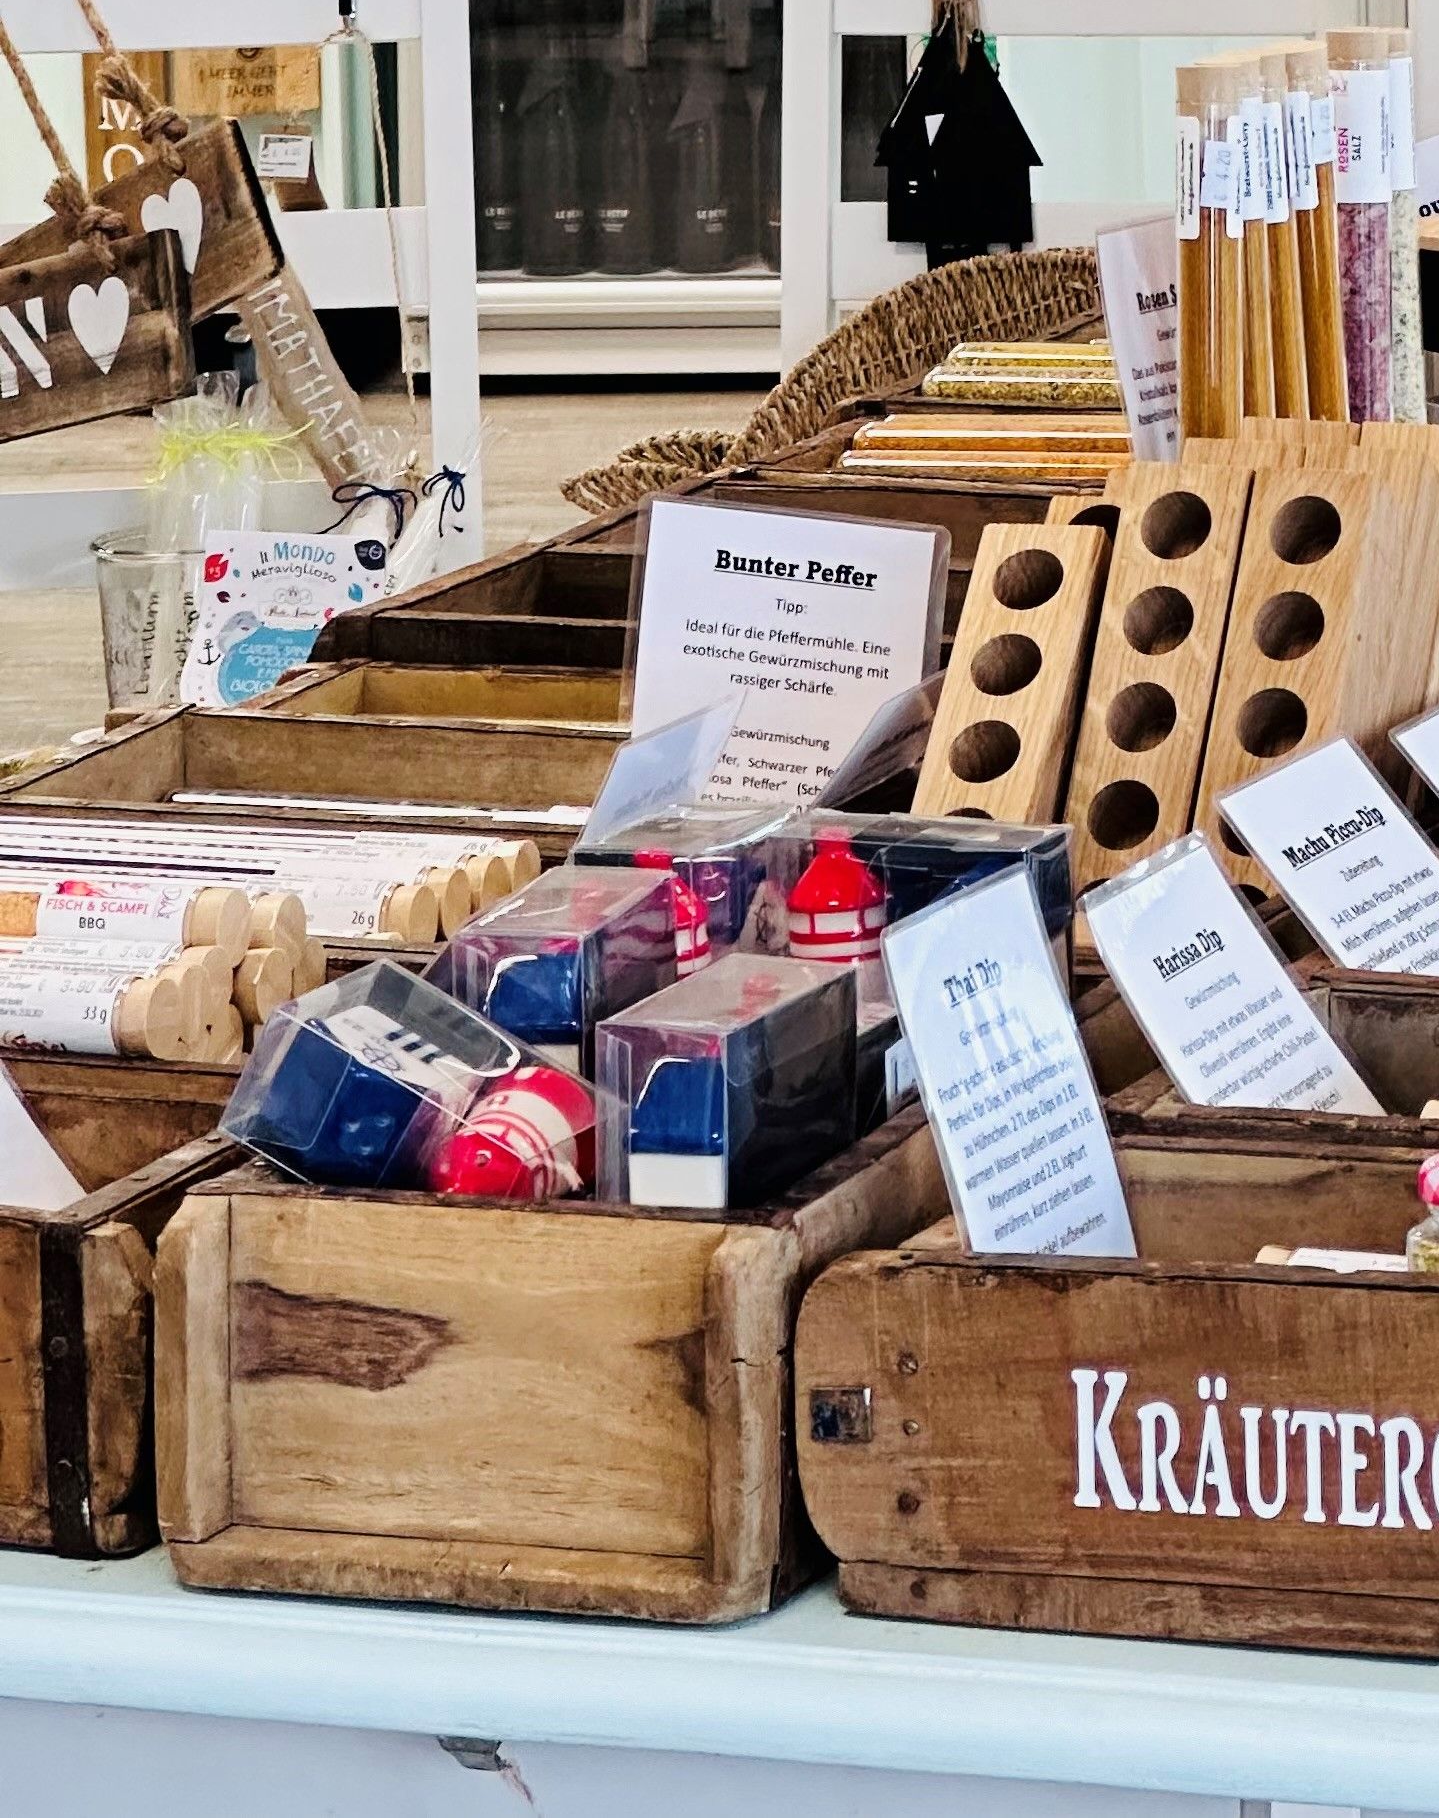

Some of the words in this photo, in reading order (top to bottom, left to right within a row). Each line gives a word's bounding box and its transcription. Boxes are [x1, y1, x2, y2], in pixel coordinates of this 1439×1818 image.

[1337, 127, 1349, 173] ROSEN
[1351, 136, 1362, 161] SALZ
[1136, 291, 1169, 311] Rosen
[715, 549, 800, 579] Bunter
[806, 560, 878, 588] Peffer
[775, 598, 808, 615] Tipp:
[686, 619, 718, 634] Ideal
[722, 623, 741, 638] für
[745, 626, 764, 642] die
[769, 630, 858, 652] Pfeffermühle.
[863, 641, 891, 657] Eine
[683, 644, 745, 661] exotische
[749, 650, 863, 677] Gewürzmischung
[867, 665, 889, 679] mit
[730, 673, 780, 691] rassiger
[784, 678, 837, 696] Schärfe.
[748, 758, 808, 775] Schwarzer
[1282, 836, 1334, 867] Machu
[1324, 806, 1385, 846] Piccu-Dip
[1340, 856, 1383, 882] Zubereitung
[46, 899, 83, 911] FISCH
[352, 911, 365, 924] 26
[1350, 900, 1377, 917] Machu
[79, 917, 106, 929] BBQ
[1153, 944, 1205, 978] Harissa
[1196, 929, 1225, 957] Dip
[1341, 935, 1363, 951] Milch
[943, 967, 978, 1003] Thai
[976, 959, 999, 987] Dip
[988, 1178, 1032, 1211] Mayonnaise
